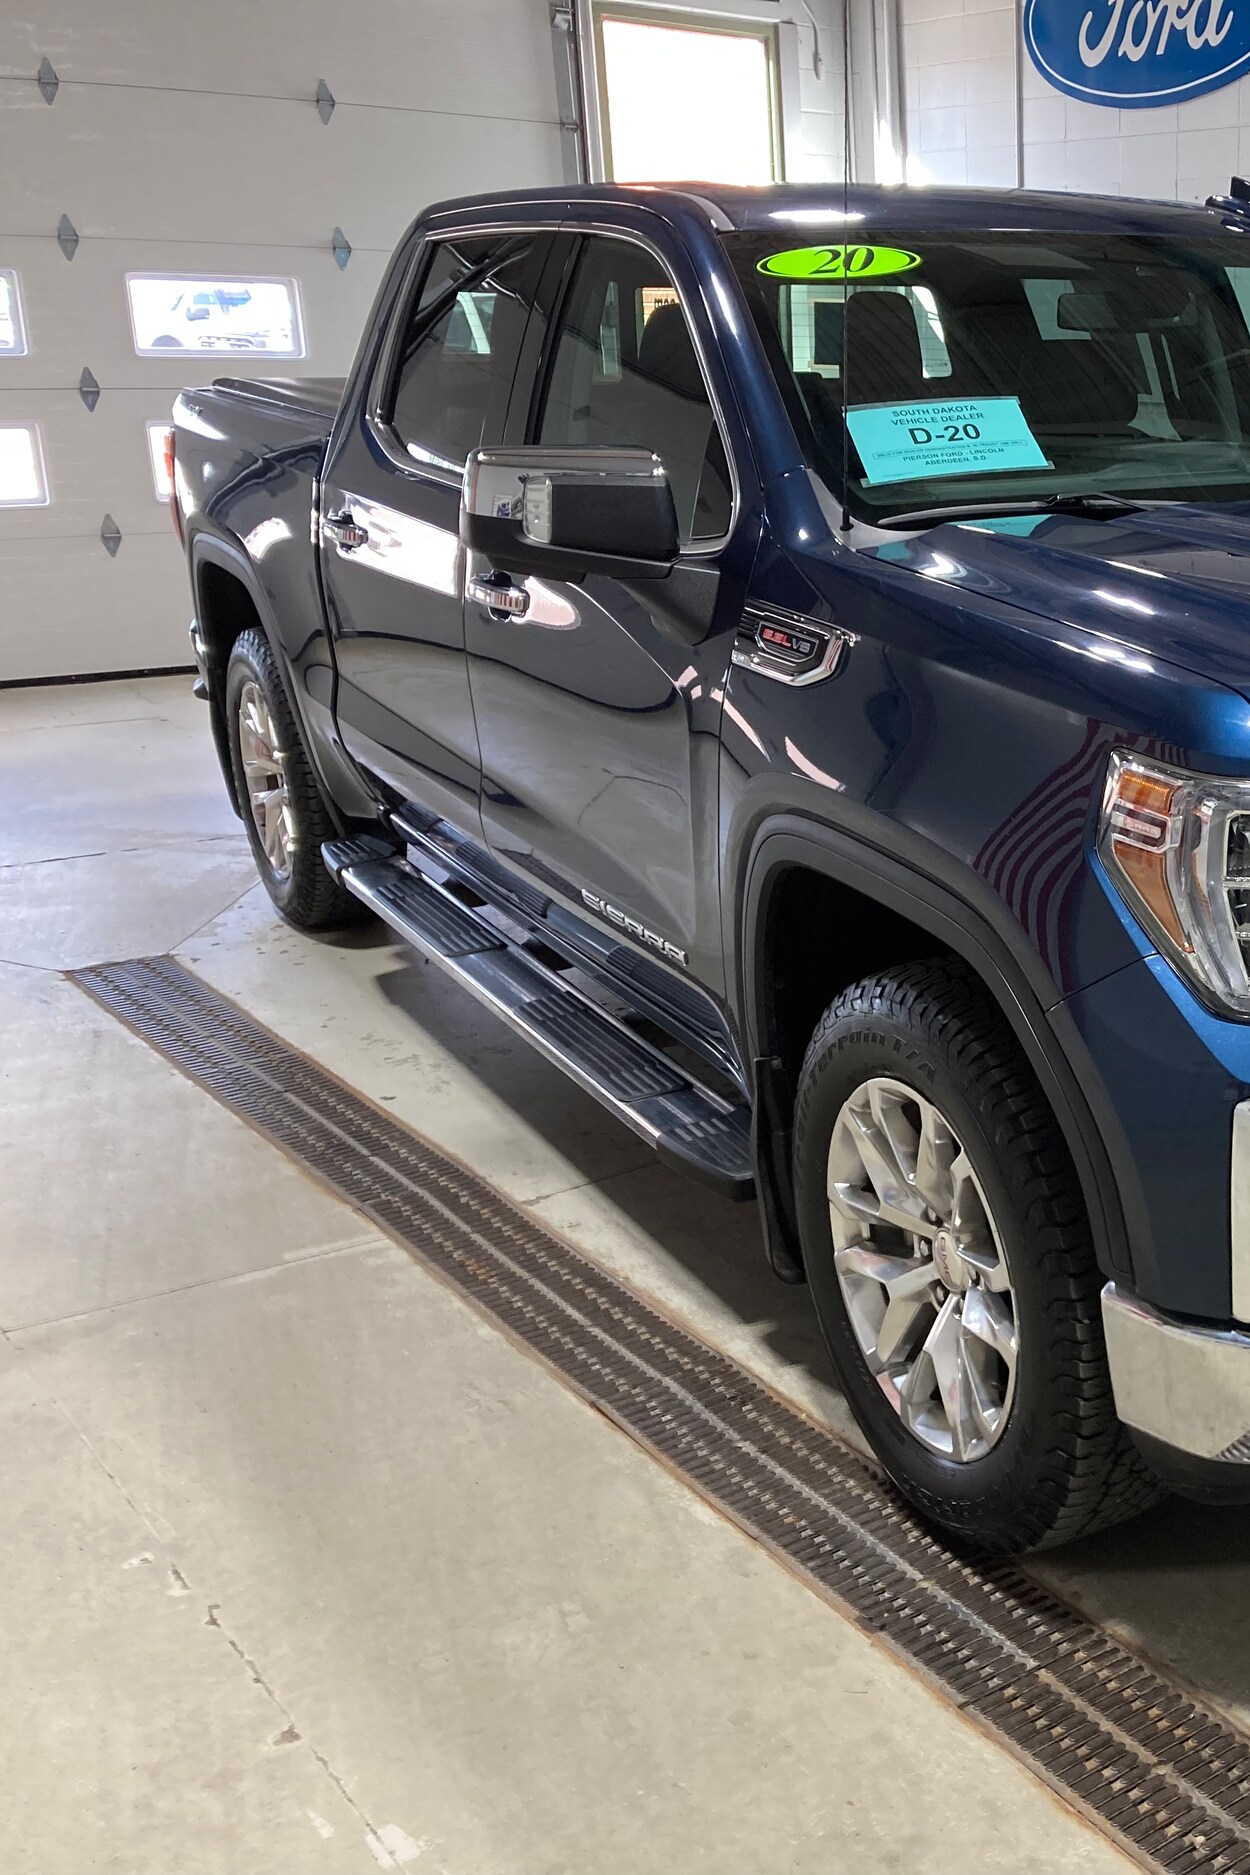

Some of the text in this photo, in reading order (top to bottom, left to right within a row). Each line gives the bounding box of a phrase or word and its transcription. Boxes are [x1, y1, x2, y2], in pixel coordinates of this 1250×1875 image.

[809, 247, 875, 275] 20
[891, 412, 985, 426] VEHICLE DEALER
[892, 405, 977, 417] SOUTH DAKOTA
[908, 423, 981, 445] D-20
[903, 453, 939, 461] PIERSON
[582, 889, 688, 966] SIERRA
